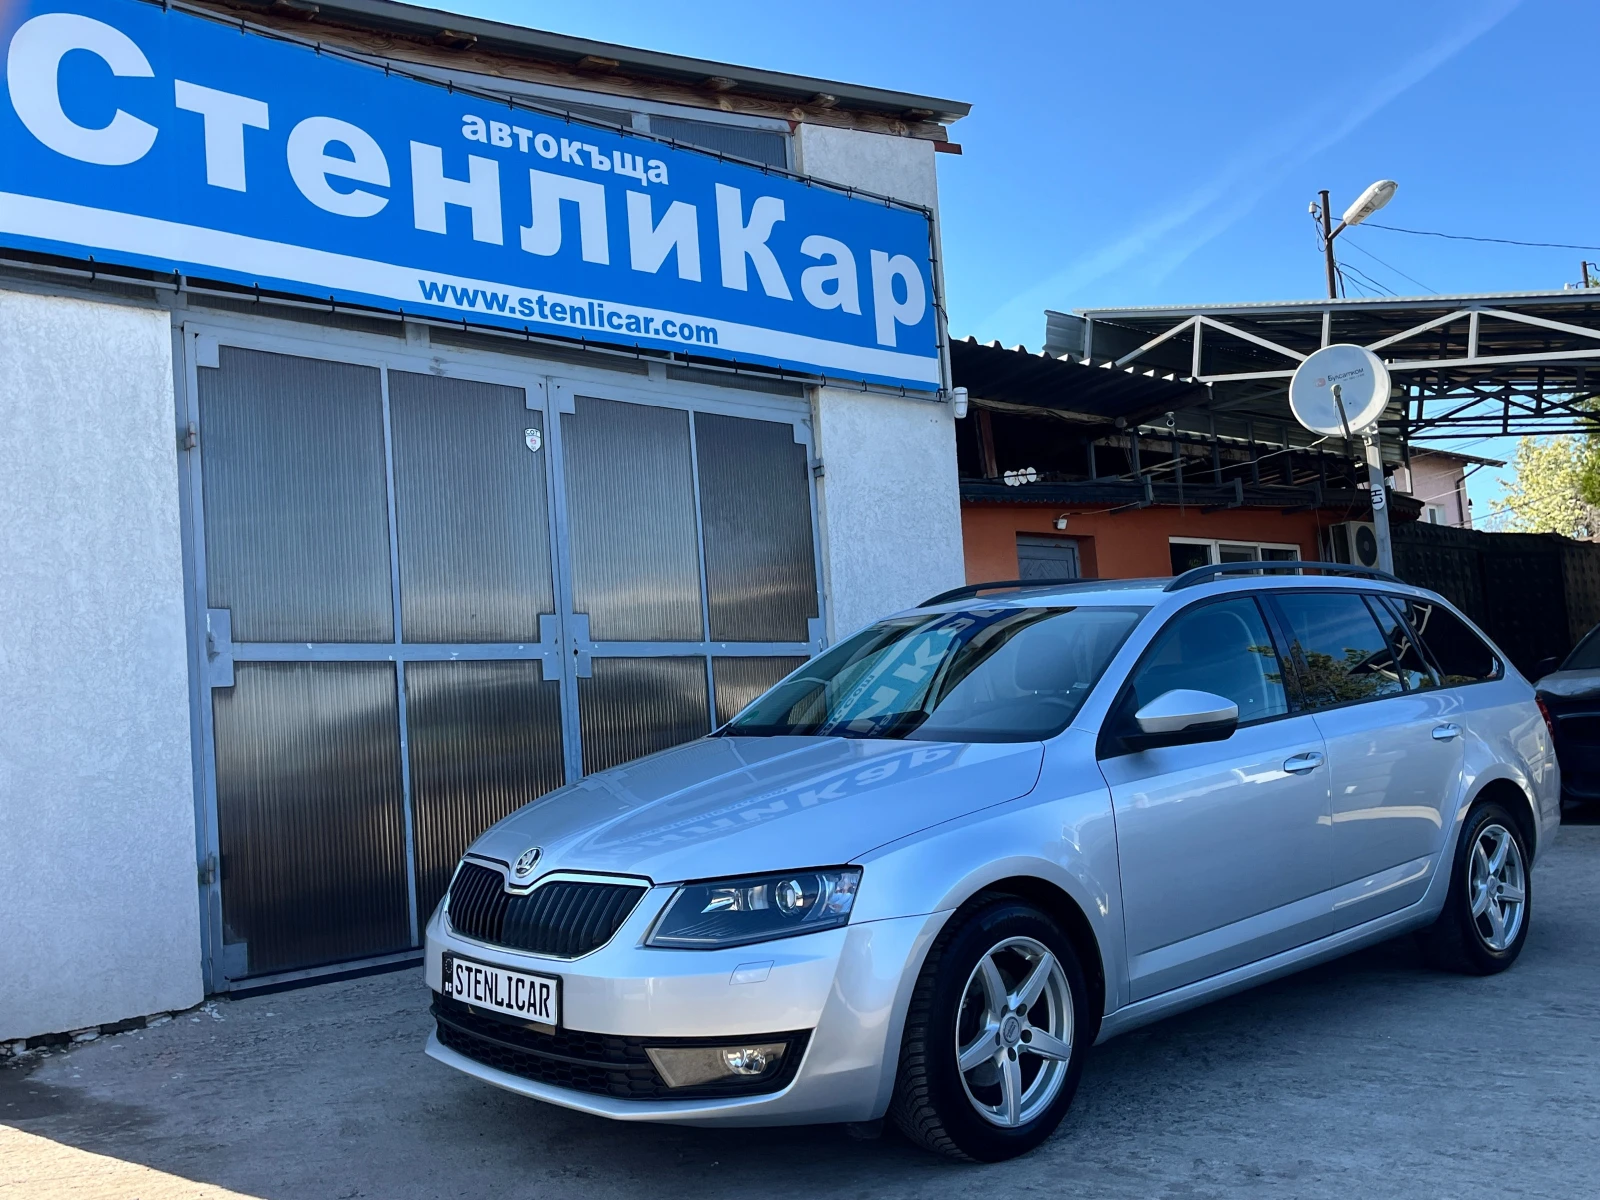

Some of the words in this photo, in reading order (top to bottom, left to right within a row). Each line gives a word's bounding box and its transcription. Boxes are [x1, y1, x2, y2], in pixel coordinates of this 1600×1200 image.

[7, 13, 926, 347] СтенлиКар
[461, 114, 669, 186] автокъща
[418, 280, 719, 345] www.stenlicar.com
[1371, 489, 1385, 505] CH
[455, 964, 551, 1018] STENLICAR
